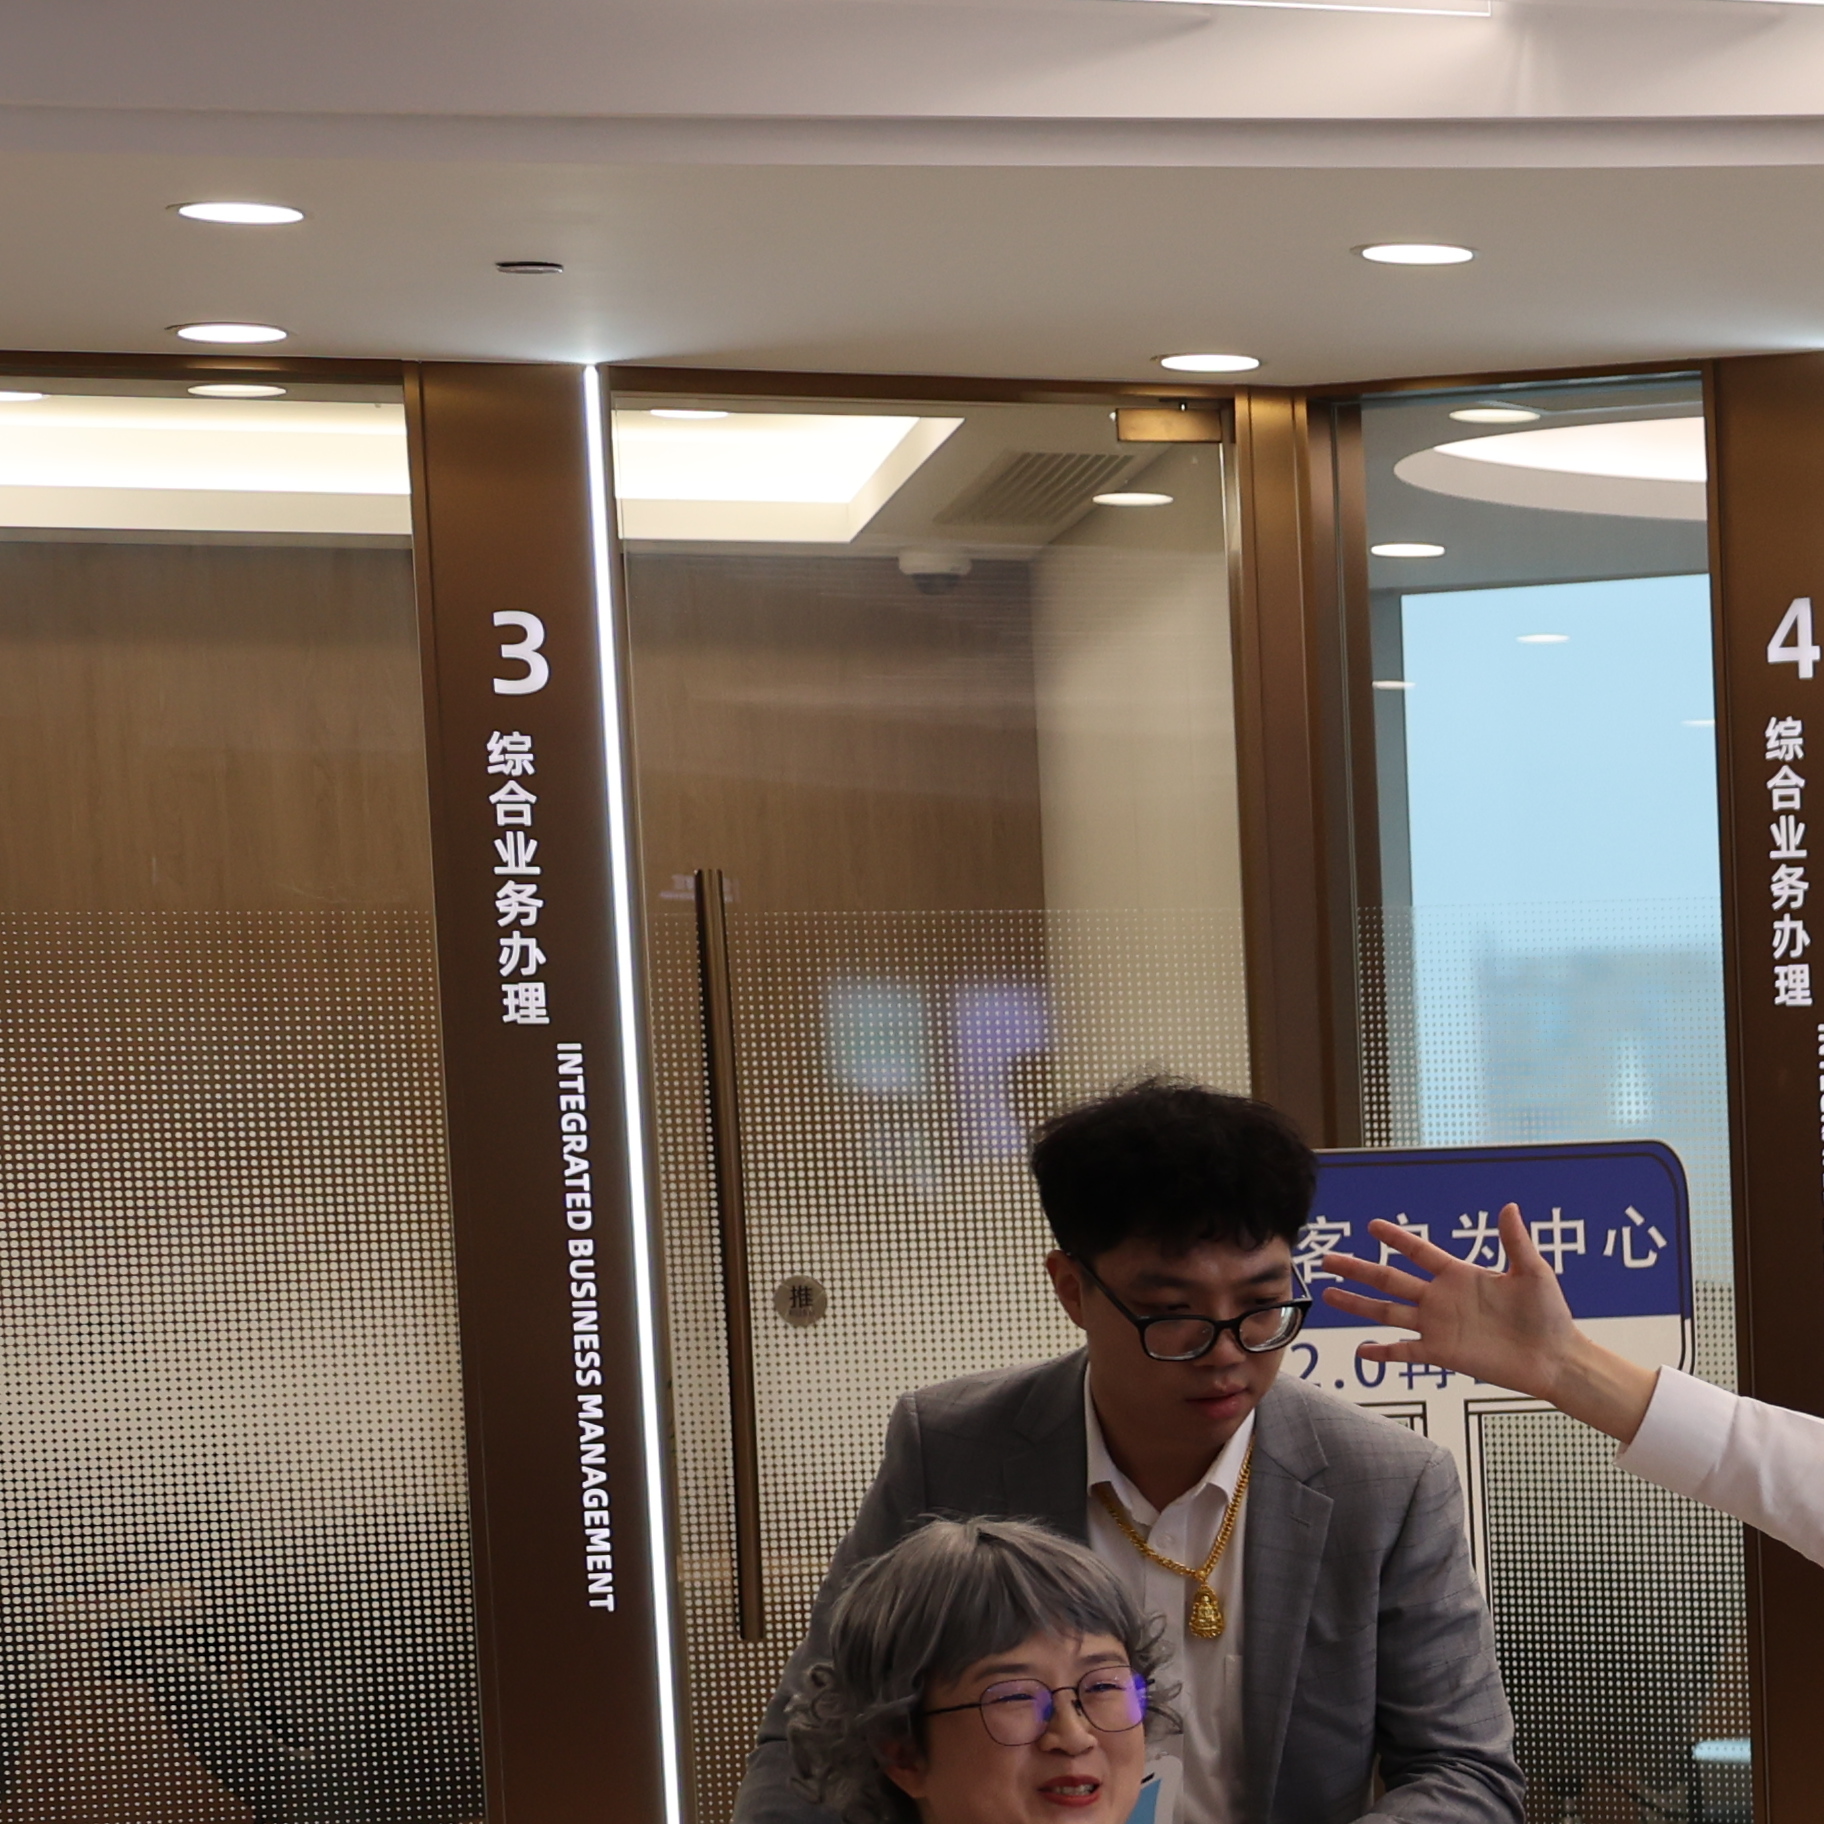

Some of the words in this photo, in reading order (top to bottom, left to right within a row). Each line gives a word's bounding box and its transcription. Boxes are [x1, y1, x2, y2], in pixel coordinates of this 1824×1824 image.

[492, 609, 550, 696] 3
[1766, 597, 1821, 680] 4
[486, 730, 551, 1026] 综合业务办理
[1764, 716, 1813, 1007] 综合业务办理
[556, 1042, 594, 1232] INTEGRATED
[567, 1238, 603, 1388] BUSINESS
[789, 1284, 813, 1309] 推
[1290, 1339, 1488, 1390] 2.0再
[577, 1394, 615, 1613] MANAGEMENT
